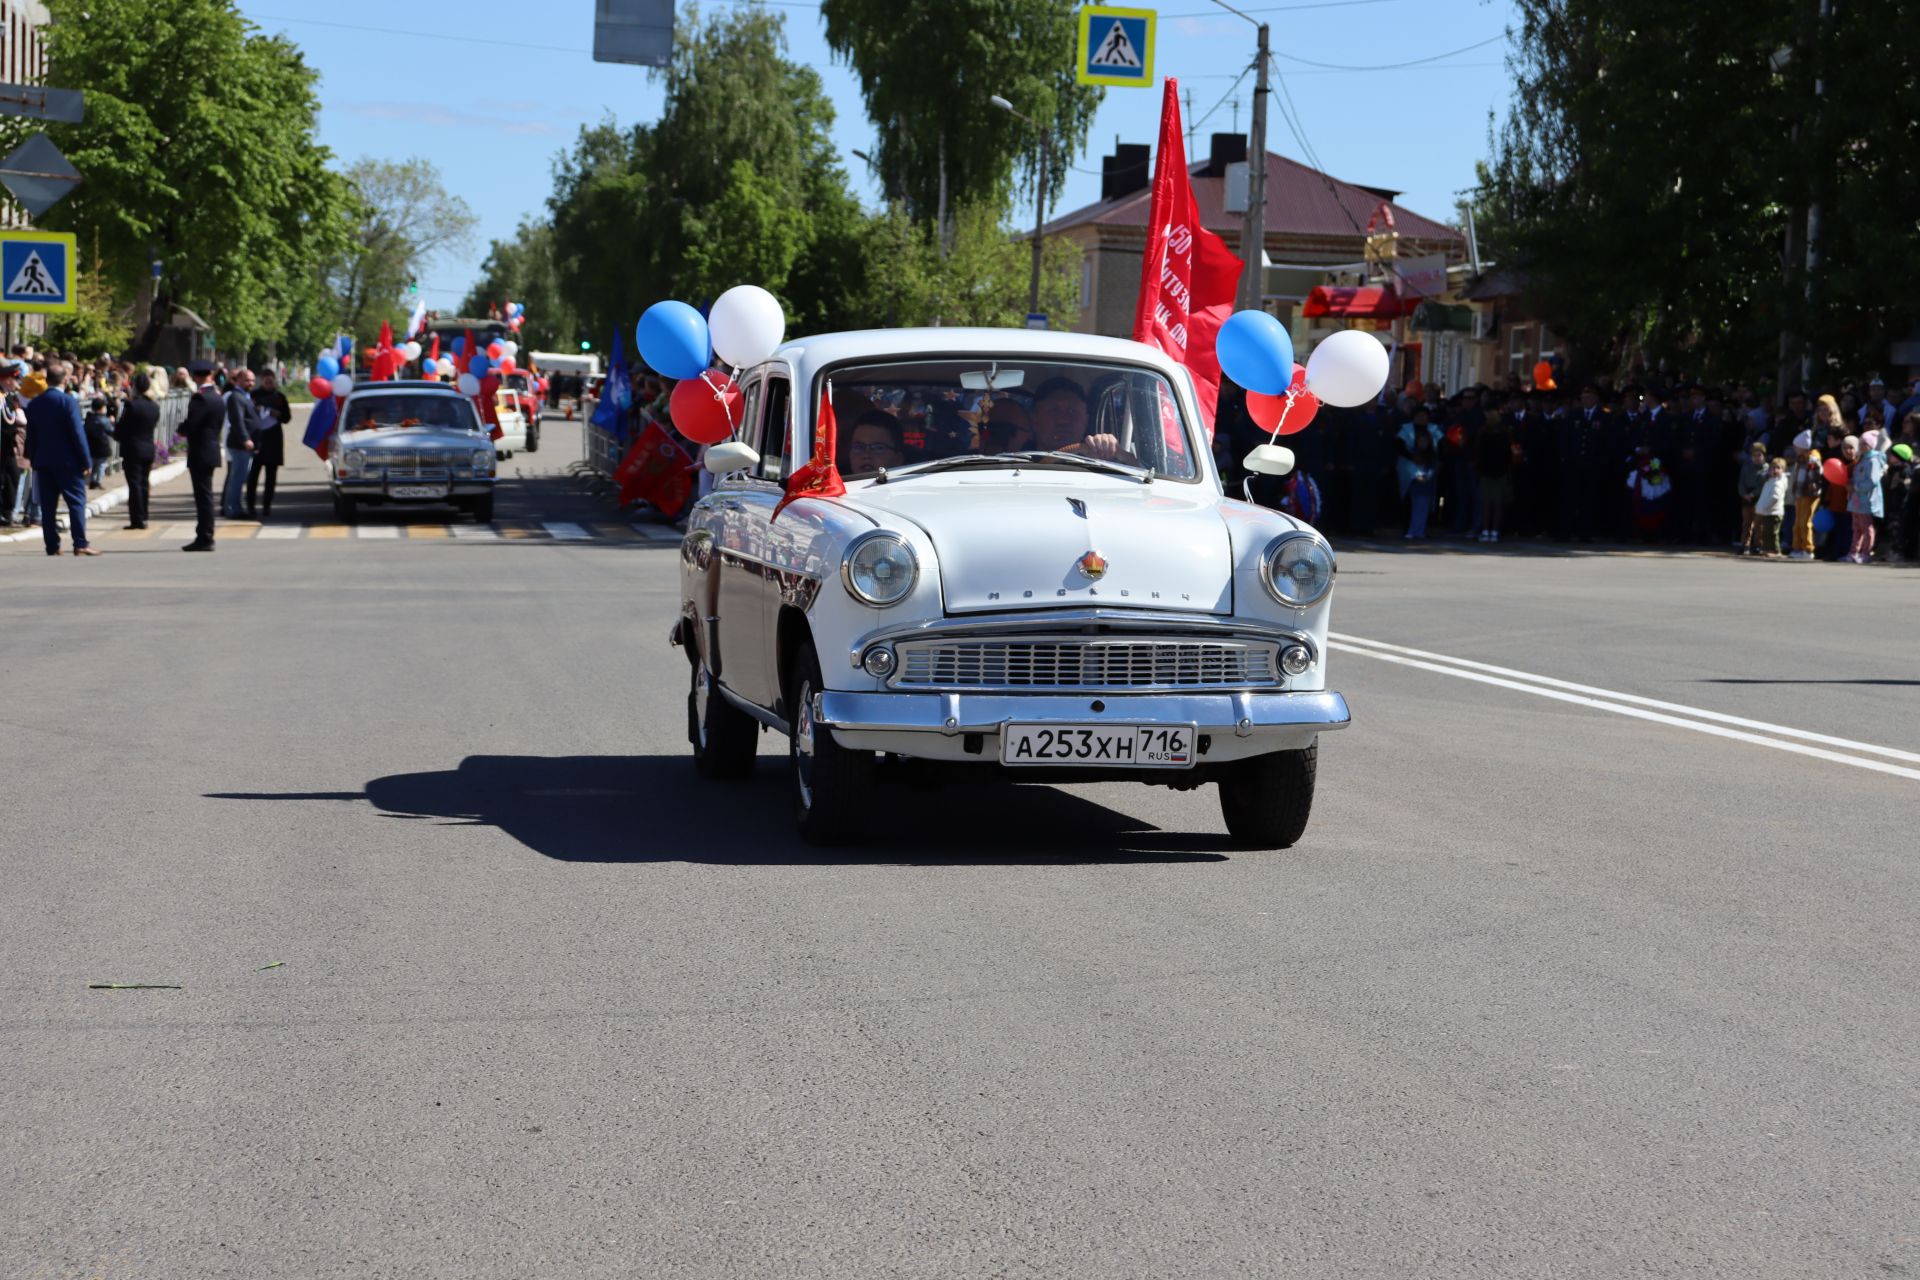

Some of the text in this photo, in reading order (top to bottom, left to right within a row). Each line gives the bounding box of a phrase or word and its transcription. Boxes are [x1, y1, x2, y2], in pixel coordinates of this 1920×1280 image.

[1015, 729, 1183, 759] А253ХН 716
[1148, 751, 1170, 761] RUS
